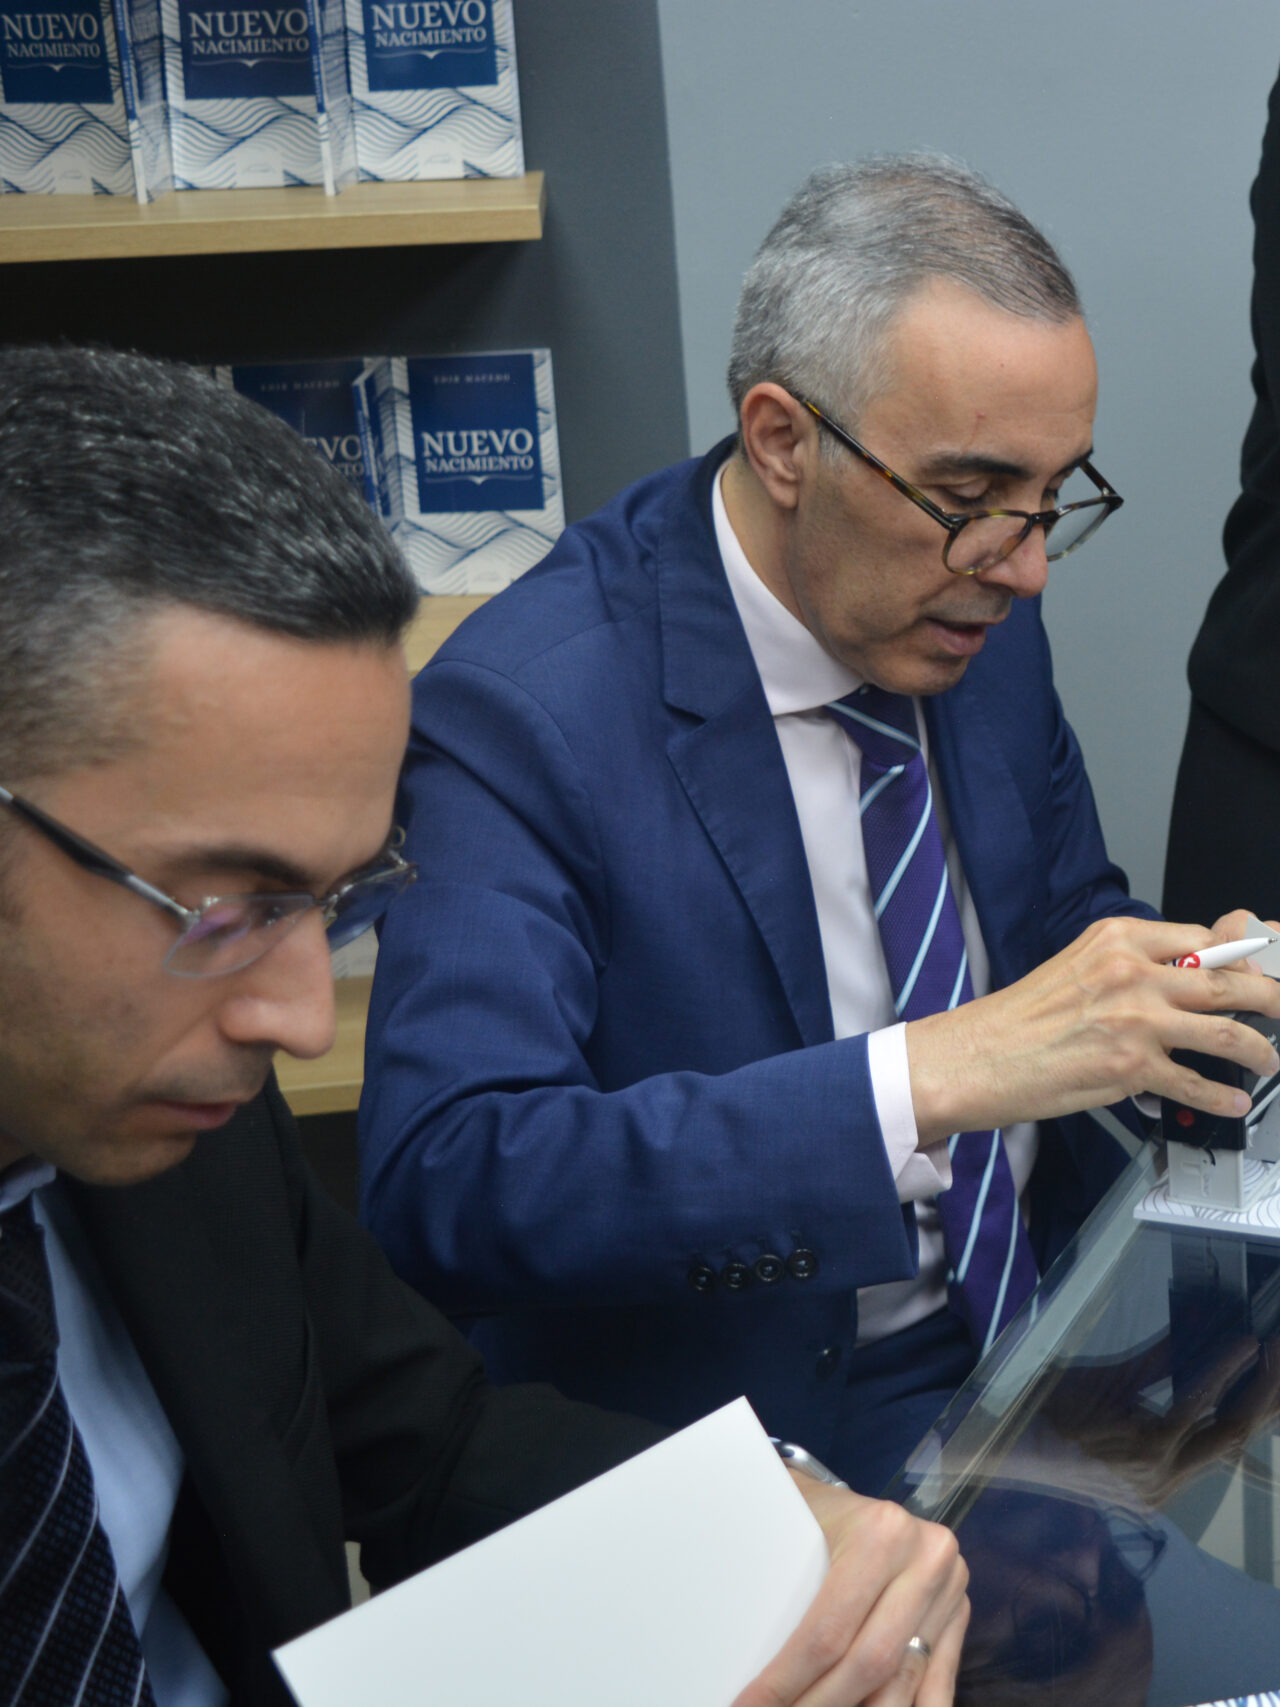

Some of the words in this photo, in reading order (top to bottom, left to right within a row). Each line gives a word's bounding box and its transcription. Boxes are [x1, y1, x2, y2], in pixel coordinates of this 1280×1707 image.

[1, 13, 98, 40] NUEVO
[188, 9, 308, 38] NUEVO
[371, 0, 486, 31] NUEVO
[192, 38, 310, 55] NACIMIENTO
[375, 27, 487, 47] NACIMIENTO
[7, 42, 101, 58] NACIMIENTO
[421, 427, 534, 457] NUEVO
[425, 455, 535, 473] NACIMIENTO
